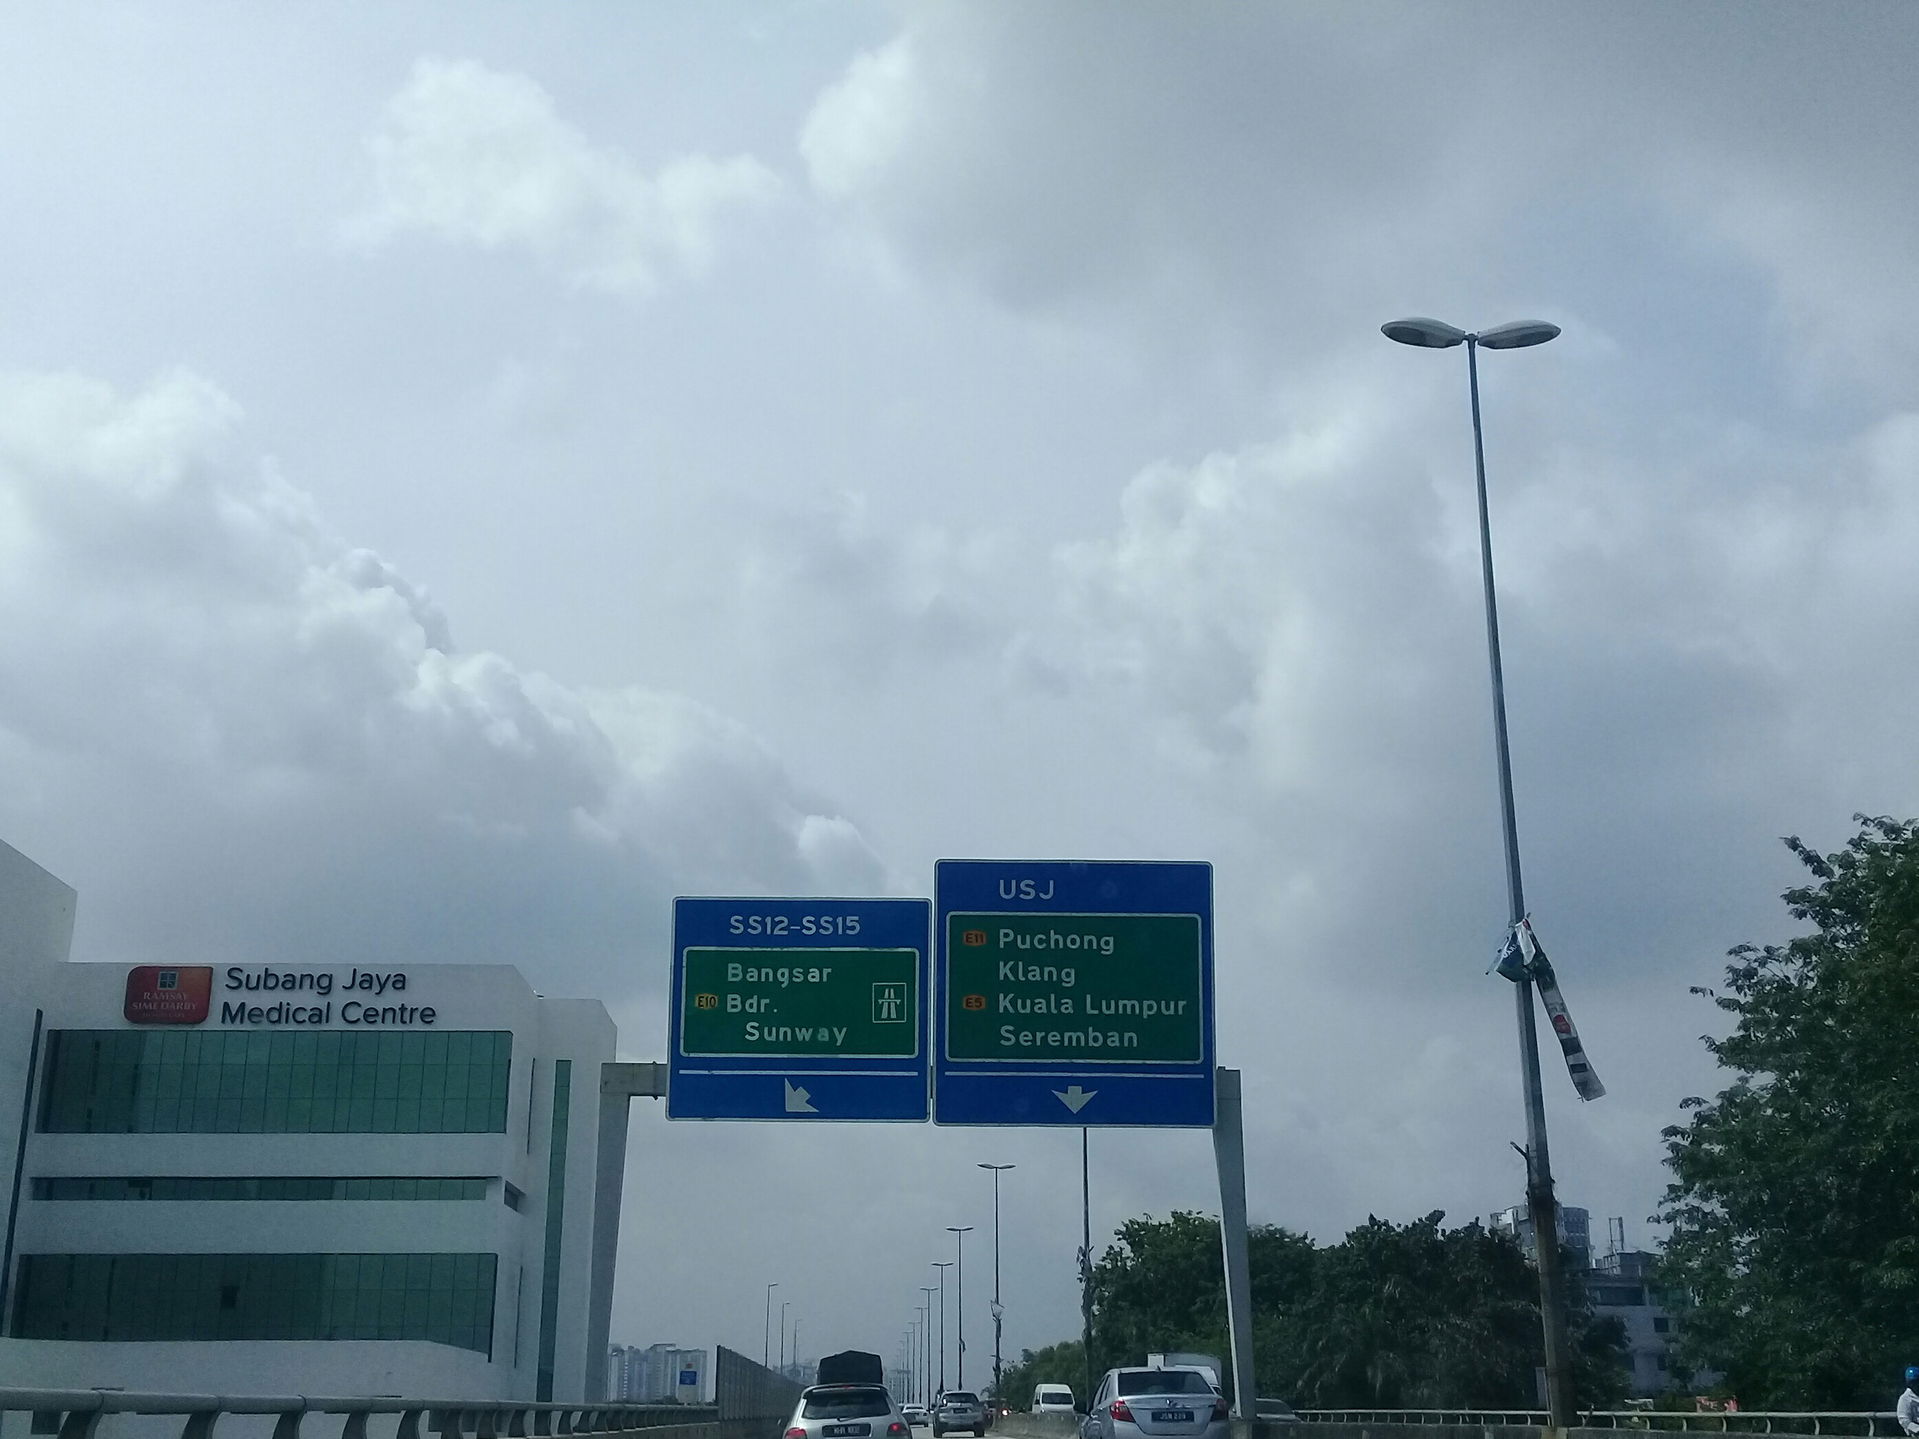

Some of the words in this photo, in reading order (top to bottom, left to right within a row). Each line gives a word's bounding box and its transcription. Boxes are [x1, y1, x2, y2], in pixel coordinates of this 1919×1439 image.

[999, 879, 1055, 900] USJ
[729, 915, 861, 935] SS12-SS15
[964, 932, 985, 944] E11
[999, 928, 1115, 955] Puchong
[225, 967, 333, 996] Subang
[342, 968, 407, 995] Jaya
[727, 962, 832, 988] Bangsar
[999, 961, 1076, 987] Klang
[221, 1001, 330, 1025] Medical
[341, 1001, 436, 1025] Centre
[697, 995, 717, 1008] E10
[726, 994, 778, 1013] Bdr.
[964, 997, 983, 1008] E5
[999, 993, 1074, 1014] Kuala
[1086, 994, 1187, 1018] Lumpur
[745, 1021, 847, 1046] Sunway
[1000, 1025, 1138, 1048] Seremban
